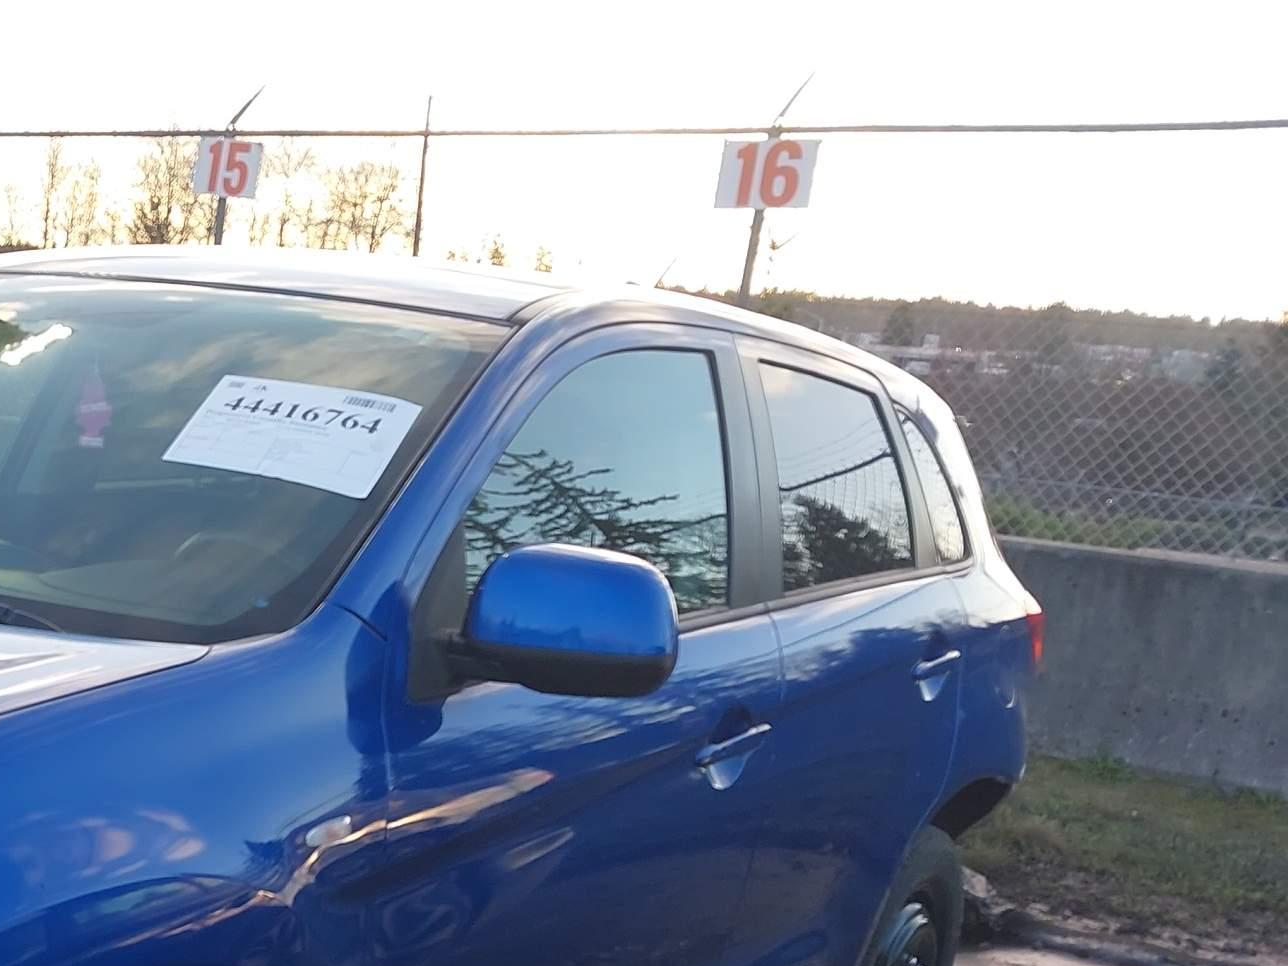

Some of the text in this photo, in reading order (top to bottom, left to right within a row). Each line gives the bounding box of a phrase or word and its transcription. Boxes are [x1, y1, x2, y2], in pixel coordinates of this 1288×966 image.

[208, 140, 251, 196] 15
[735, 140, 803, 207] 16
[223, 396, 383, 434] 44416764
